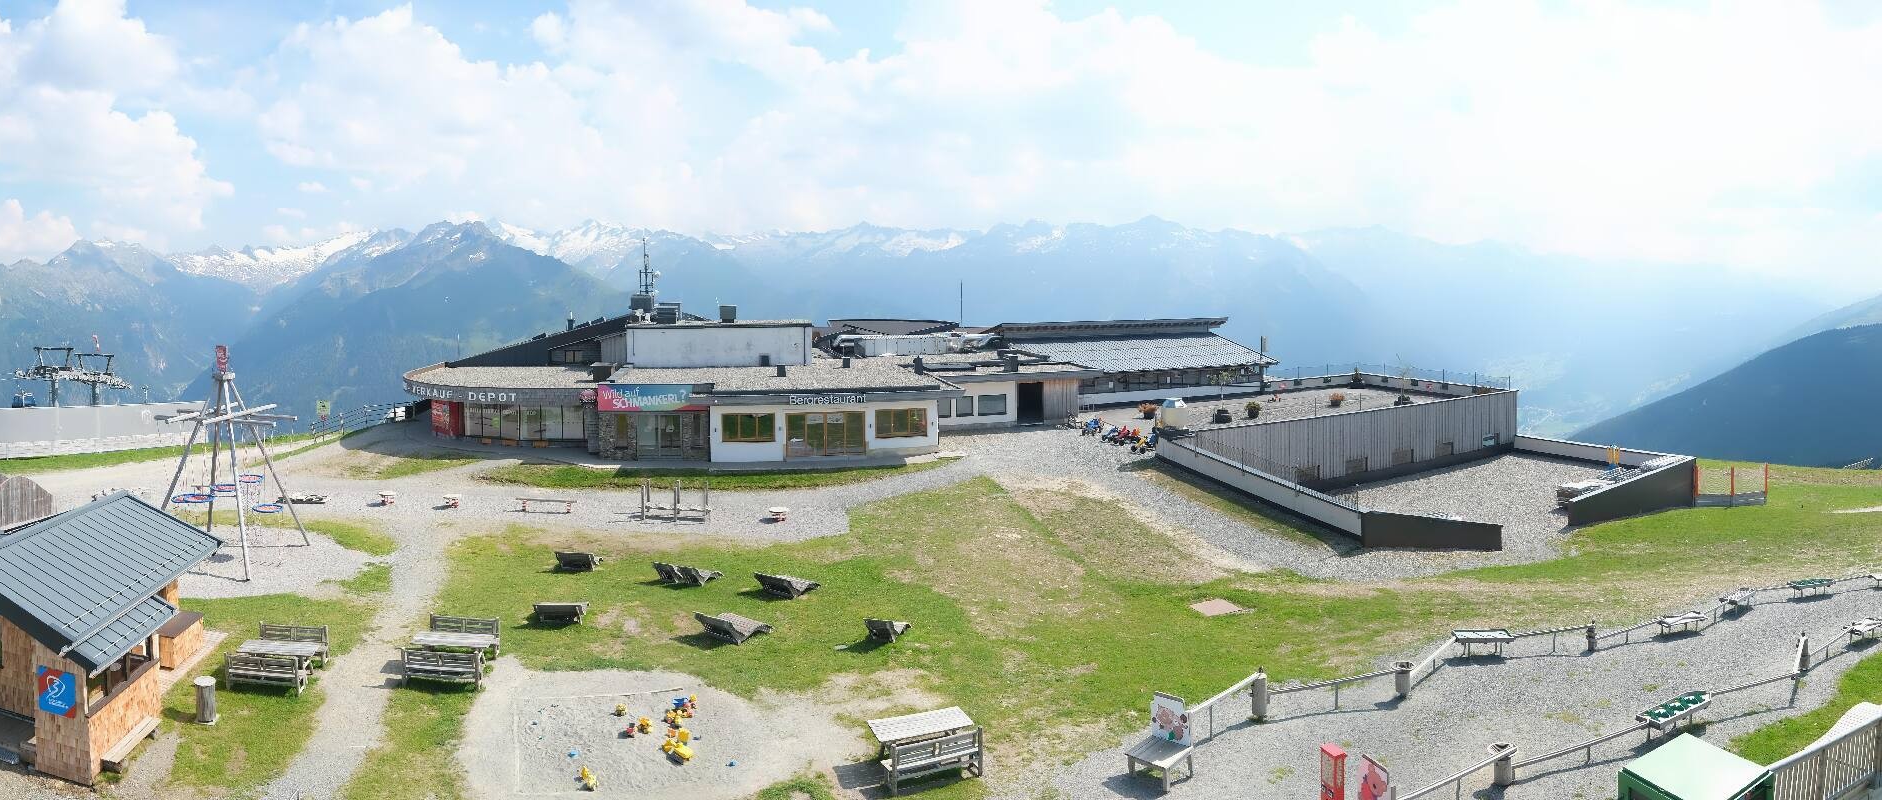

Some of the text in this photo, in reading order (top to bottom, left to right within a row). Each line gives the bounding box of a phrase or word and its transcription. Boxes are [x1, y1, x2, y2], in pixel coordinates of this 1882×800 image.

[412, 386, 453, 399] VERKAUF
[468, 391, 517, 402] DEPOT
[602, 388, 623, 399] Wild
[624, 386, 640, 398] auf
[612, 389, 687, 409] SCHMANKERL?
[790, 394, 866, 405] Bergrestaurant
